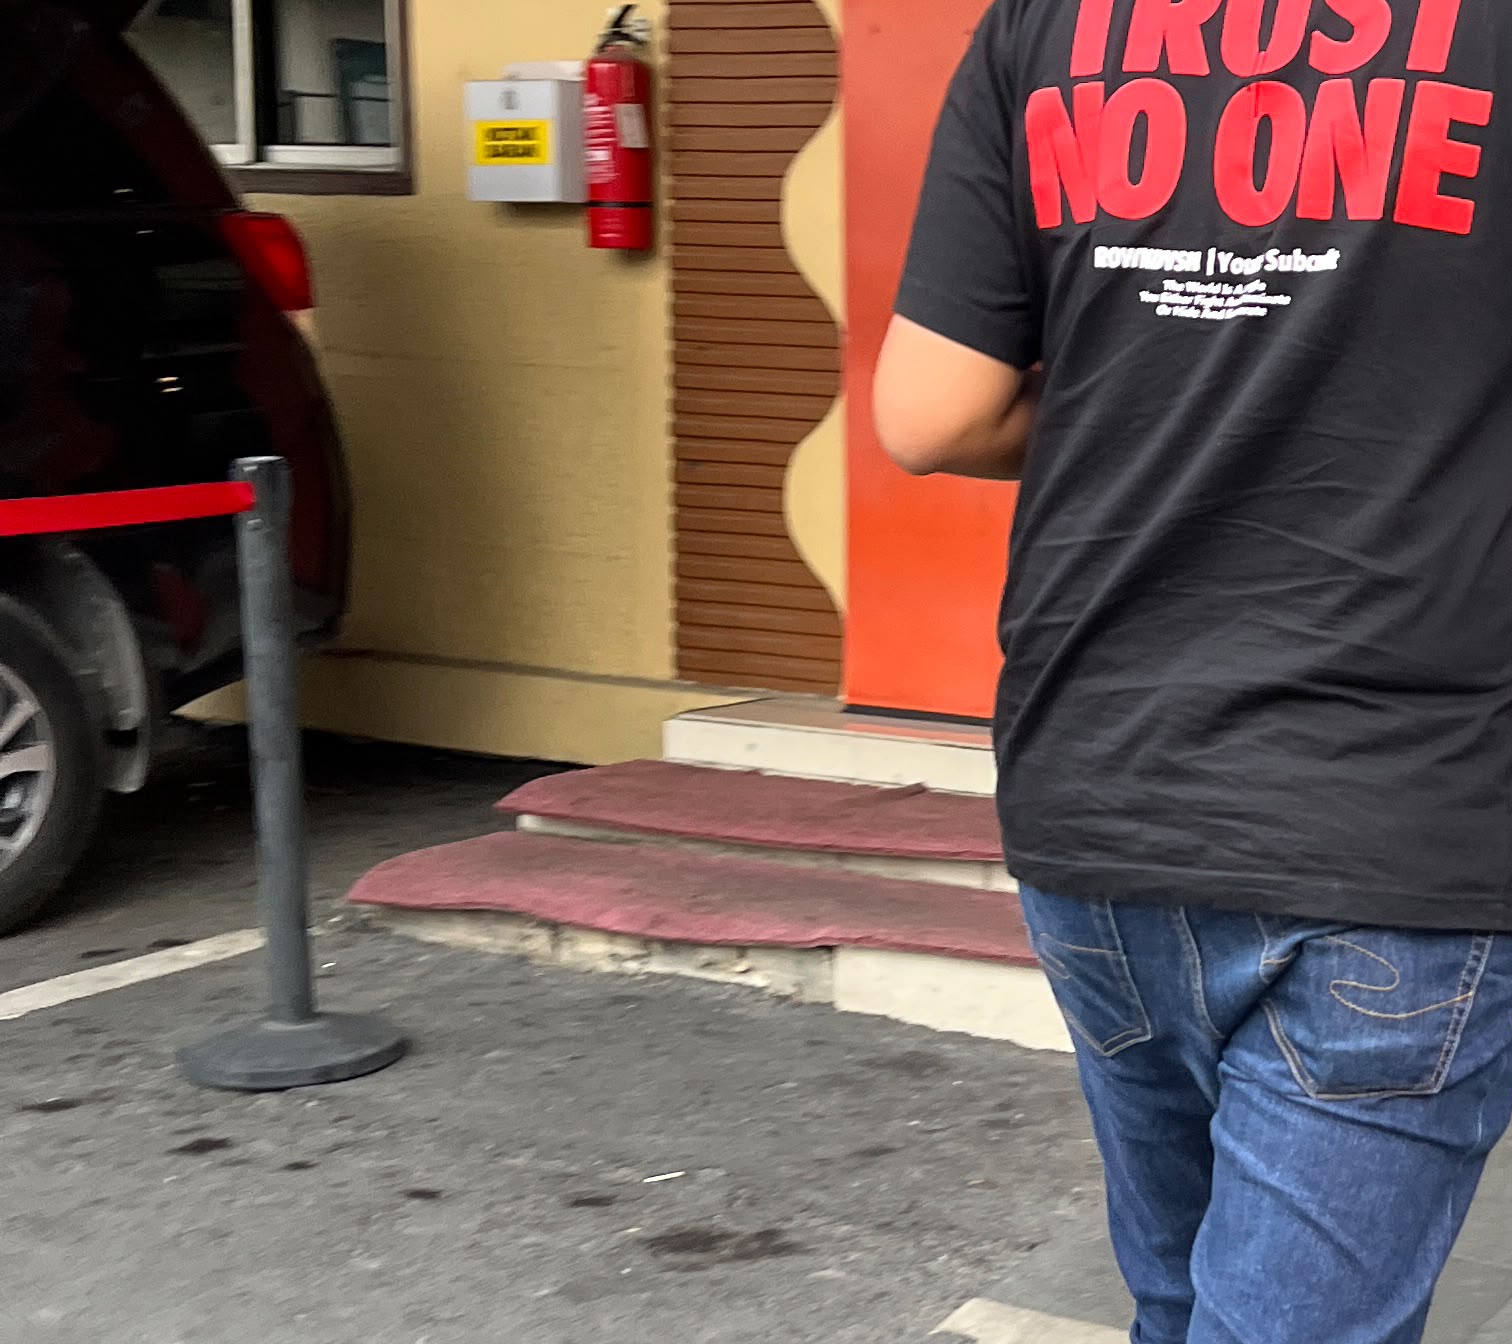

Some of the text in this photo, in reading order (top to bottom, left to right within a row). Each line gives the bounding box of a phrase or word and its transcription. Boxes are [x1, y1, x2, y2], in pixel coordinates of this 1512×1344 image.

[1025, 76, 1493, 235] NO ONE
[1217, 251, 1265, 275] Your
